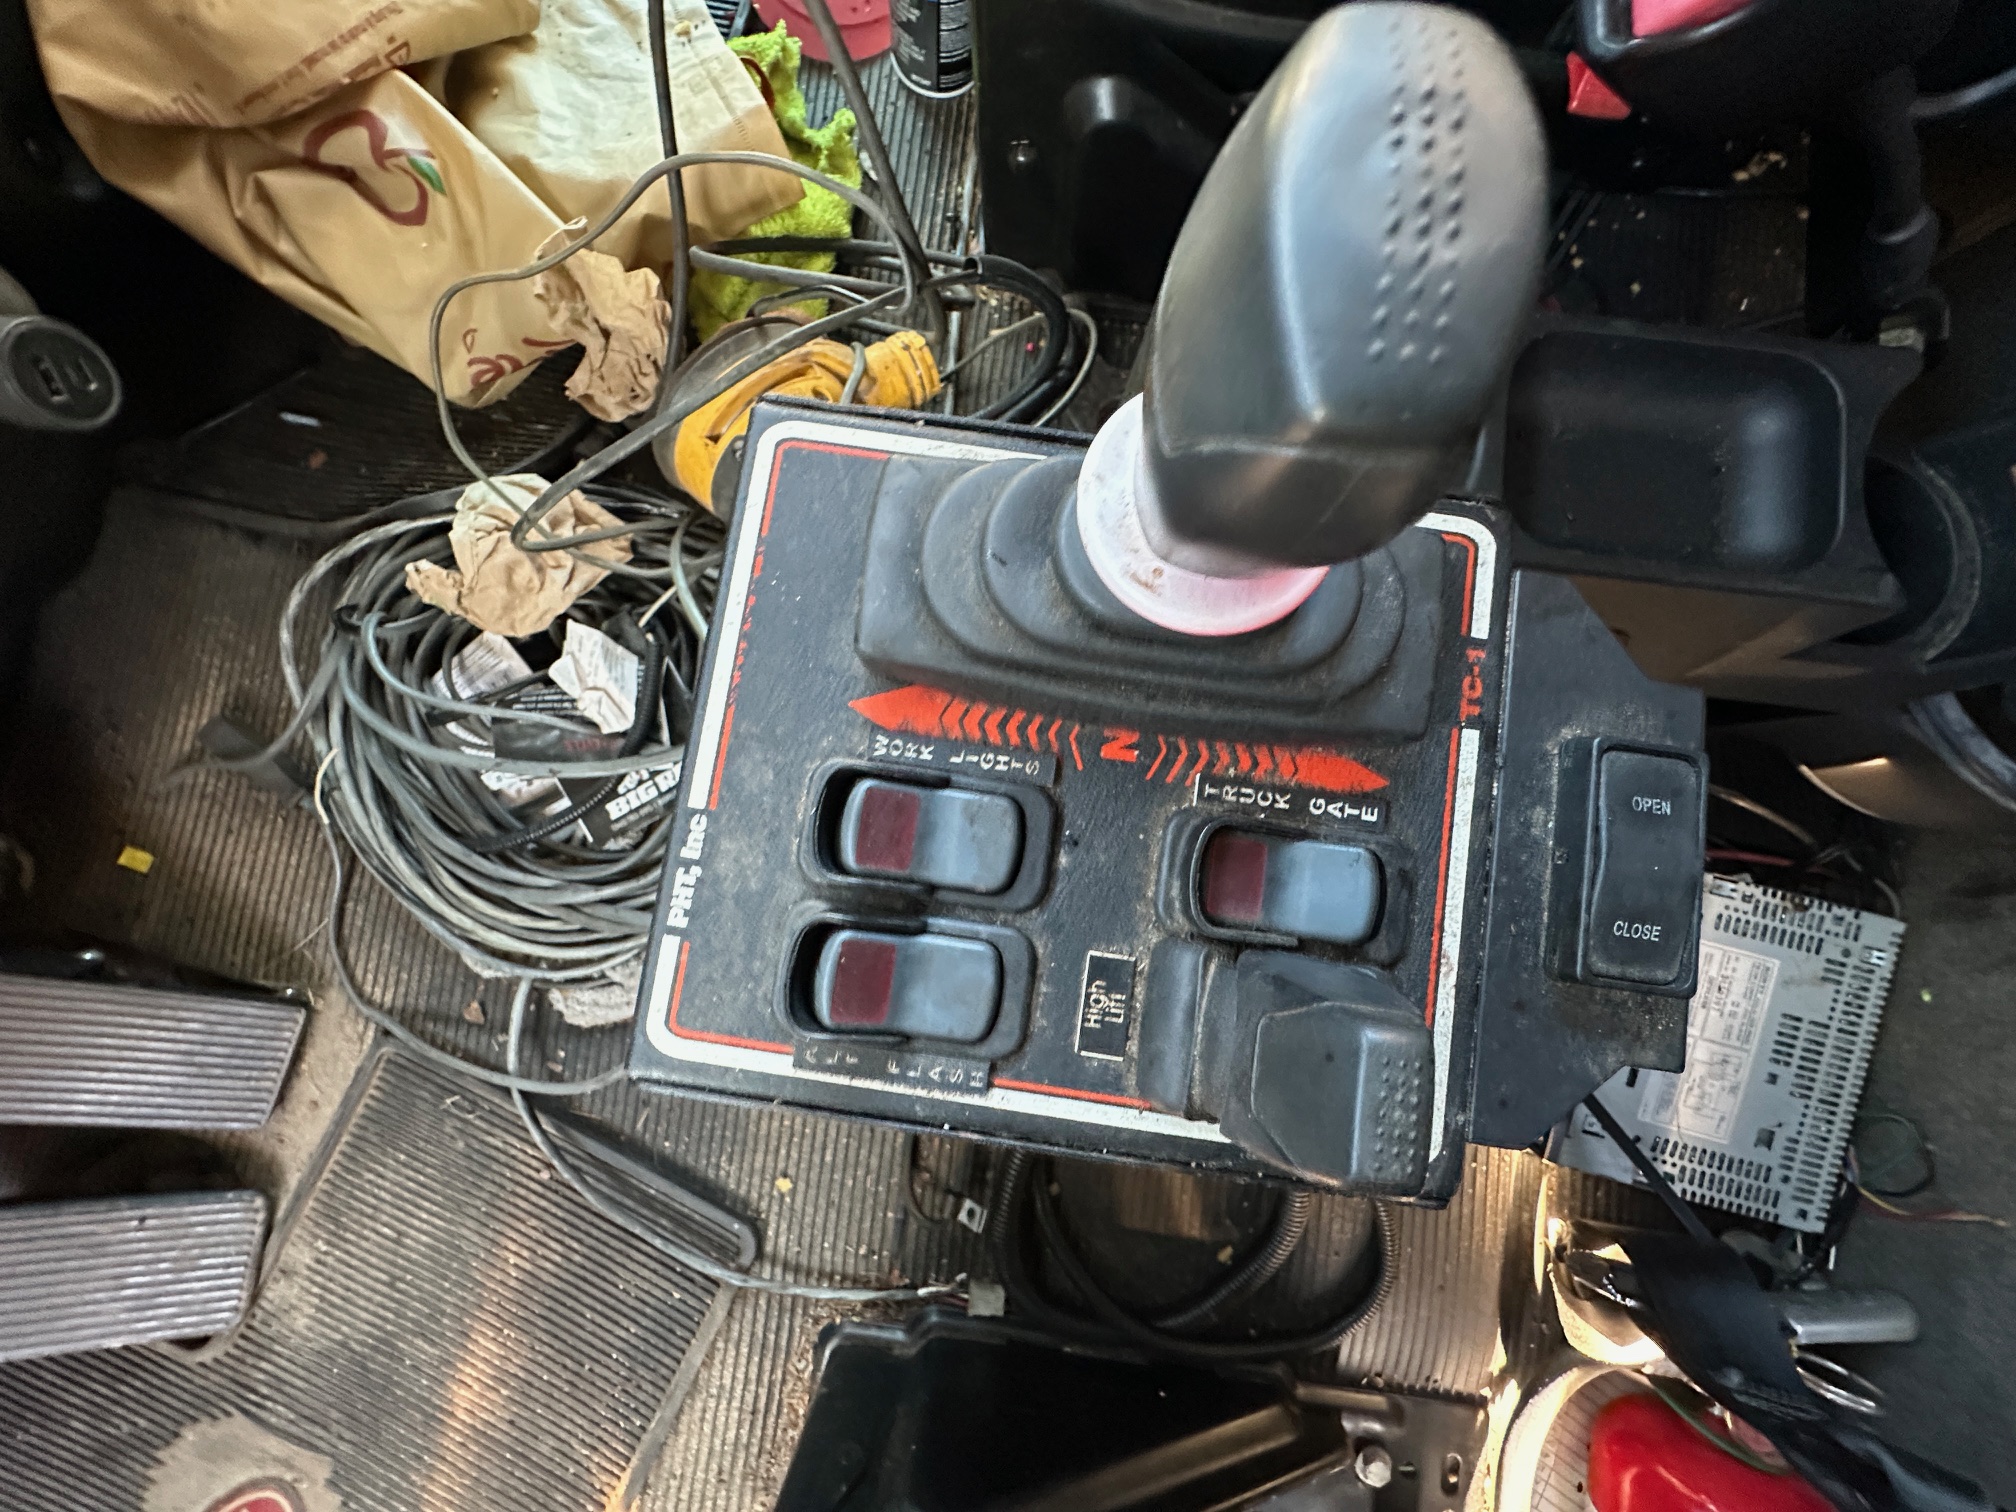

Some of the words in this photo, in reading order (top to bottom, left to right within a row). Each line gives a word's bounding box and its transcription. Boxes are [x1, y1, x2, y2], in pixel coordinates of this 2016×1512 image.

[1459, 647, 1486, 722] TC-1
[871, 732, 936, 761] WORK
[948, 746, 1041, 776] LIGHTS
[604, 779, 659, 821] BIG
[1203, 782, 1292, 811] TRUCK
[1308, 796, 1379, 823] GATE
[1631, 795, 1672, 816] OPEN
[679, 812, 708, 861] Inc
[1612, 919, 1662, 942] CLOSE
[1083, 979, 1107, 1029] High
[1104, 991, 1126, 1024] Lift
[886, 1057, 986, 1088] FLASH
